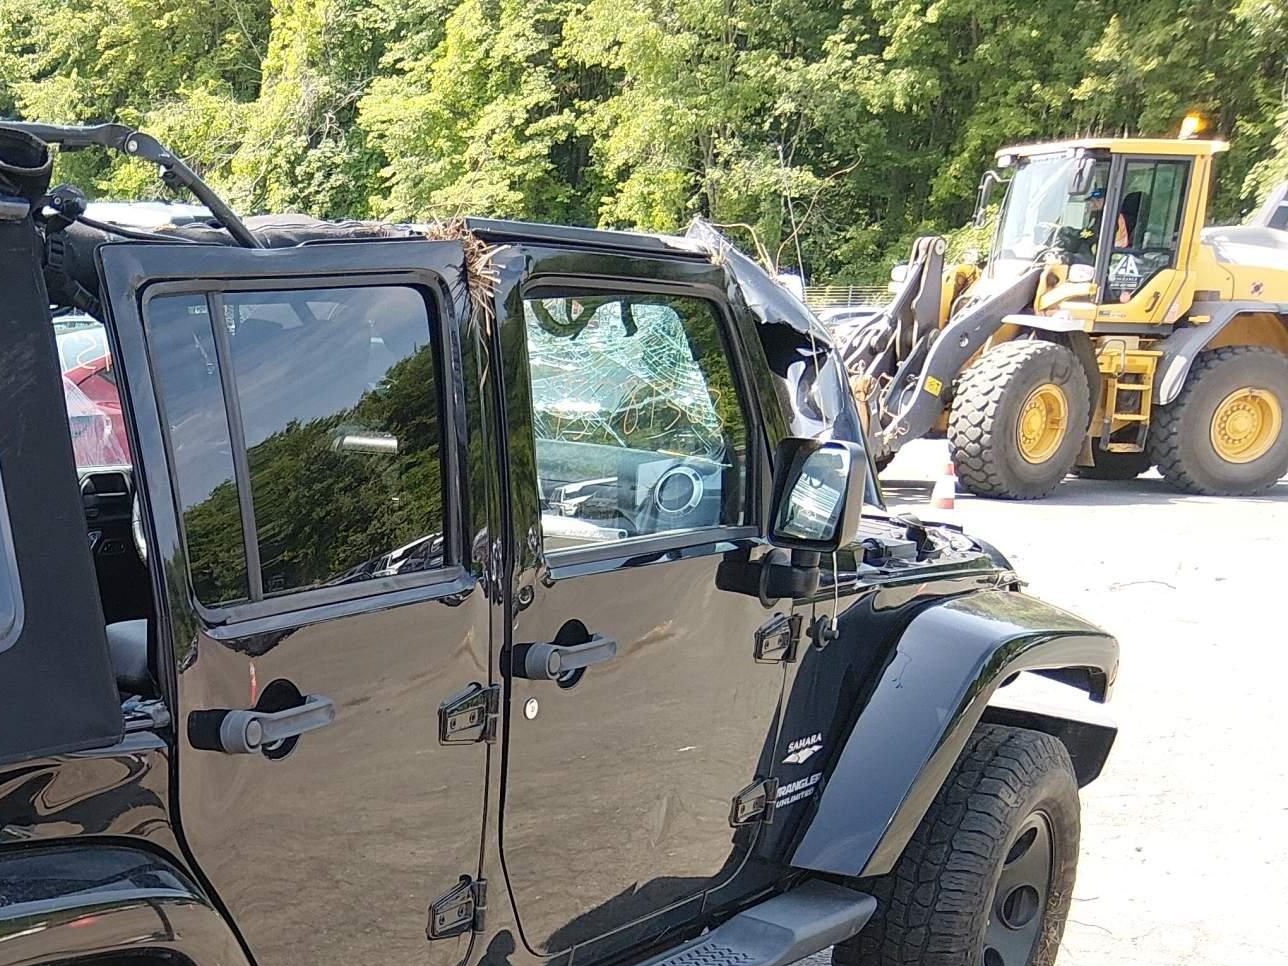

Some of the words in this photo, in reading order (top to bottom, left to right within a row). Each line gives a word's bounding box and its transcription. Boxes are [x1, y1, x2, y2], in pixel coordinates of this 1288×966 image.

[787, 732, 822, 754] SAHARA
[775, 771, 823, 799] RANGLER
[775, 786, 815, 809] UNLIMITED
